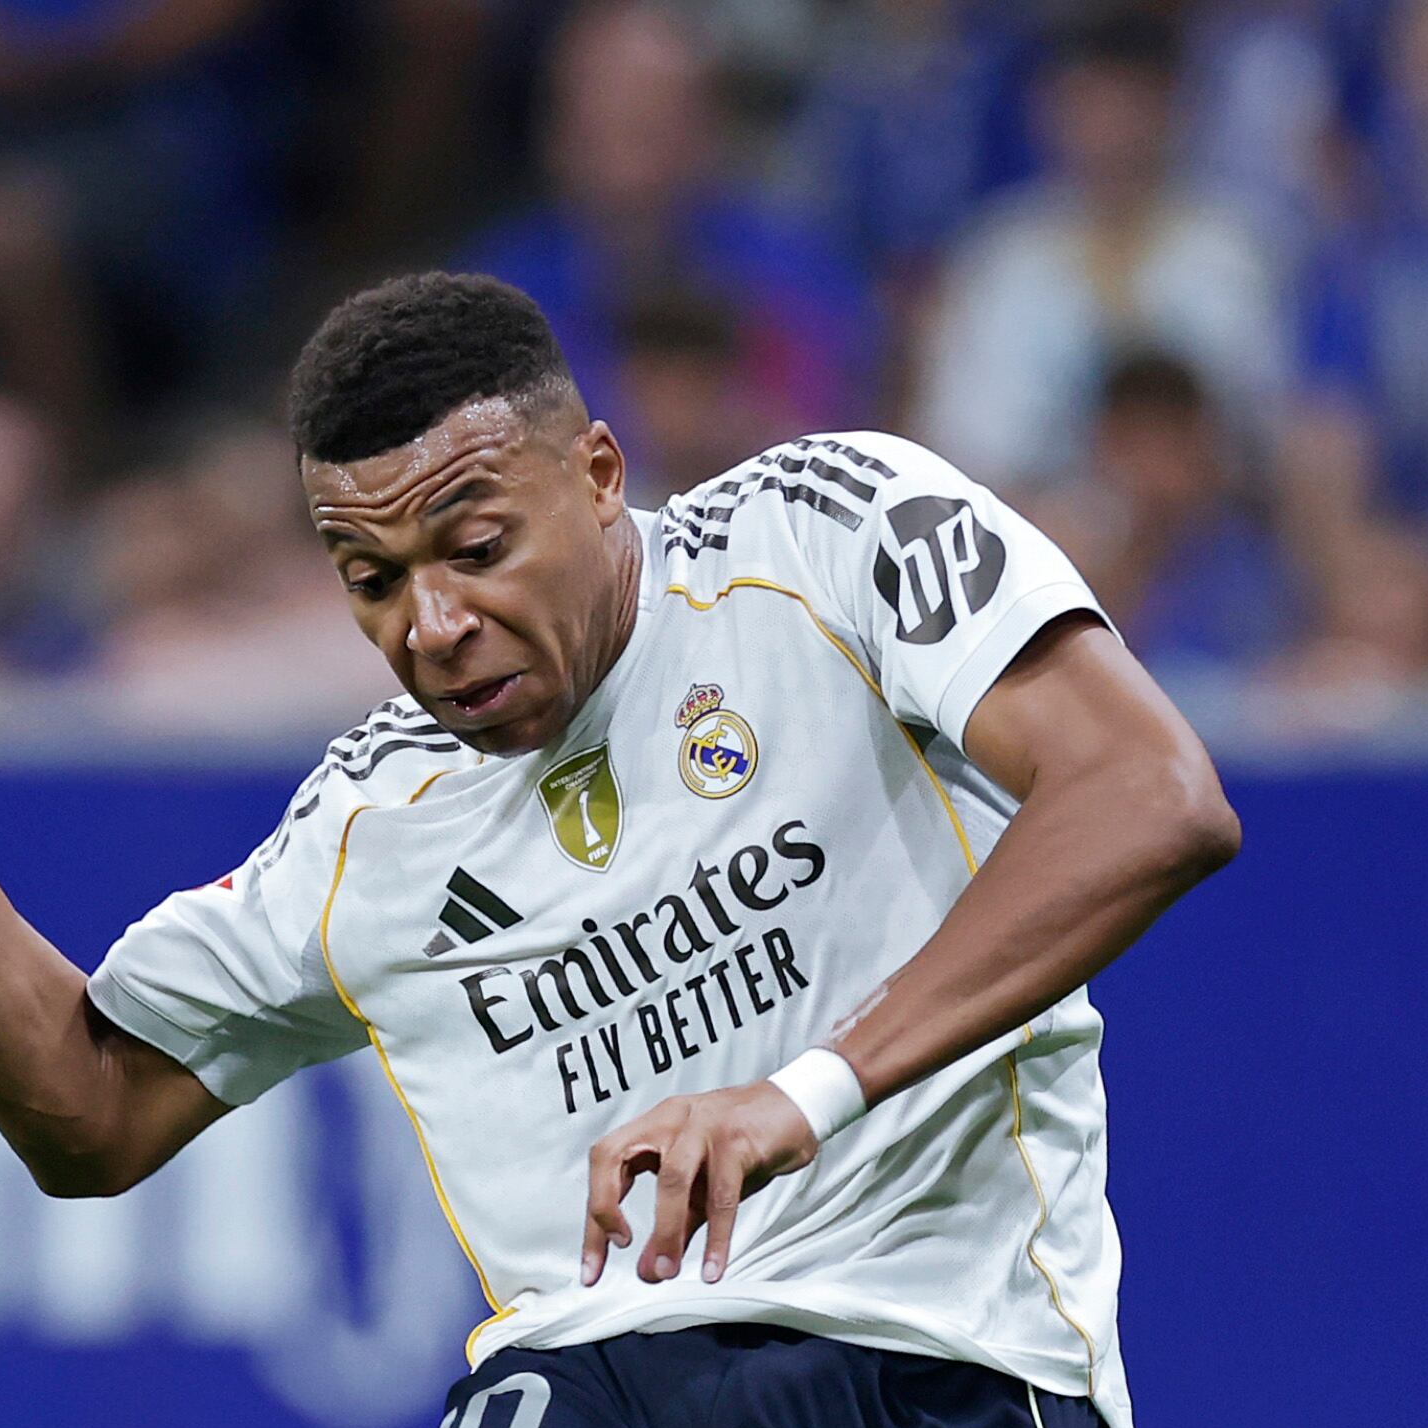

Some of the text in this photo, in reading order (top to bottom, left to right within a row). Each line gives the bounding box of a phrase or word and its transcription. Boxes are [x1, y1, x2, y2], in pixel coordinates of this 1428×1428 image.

[876, 497, 999, 643] hp
[459, 819, 826, 1055] Emirates
[556, 927, 810, 1114] FLY BETTER
